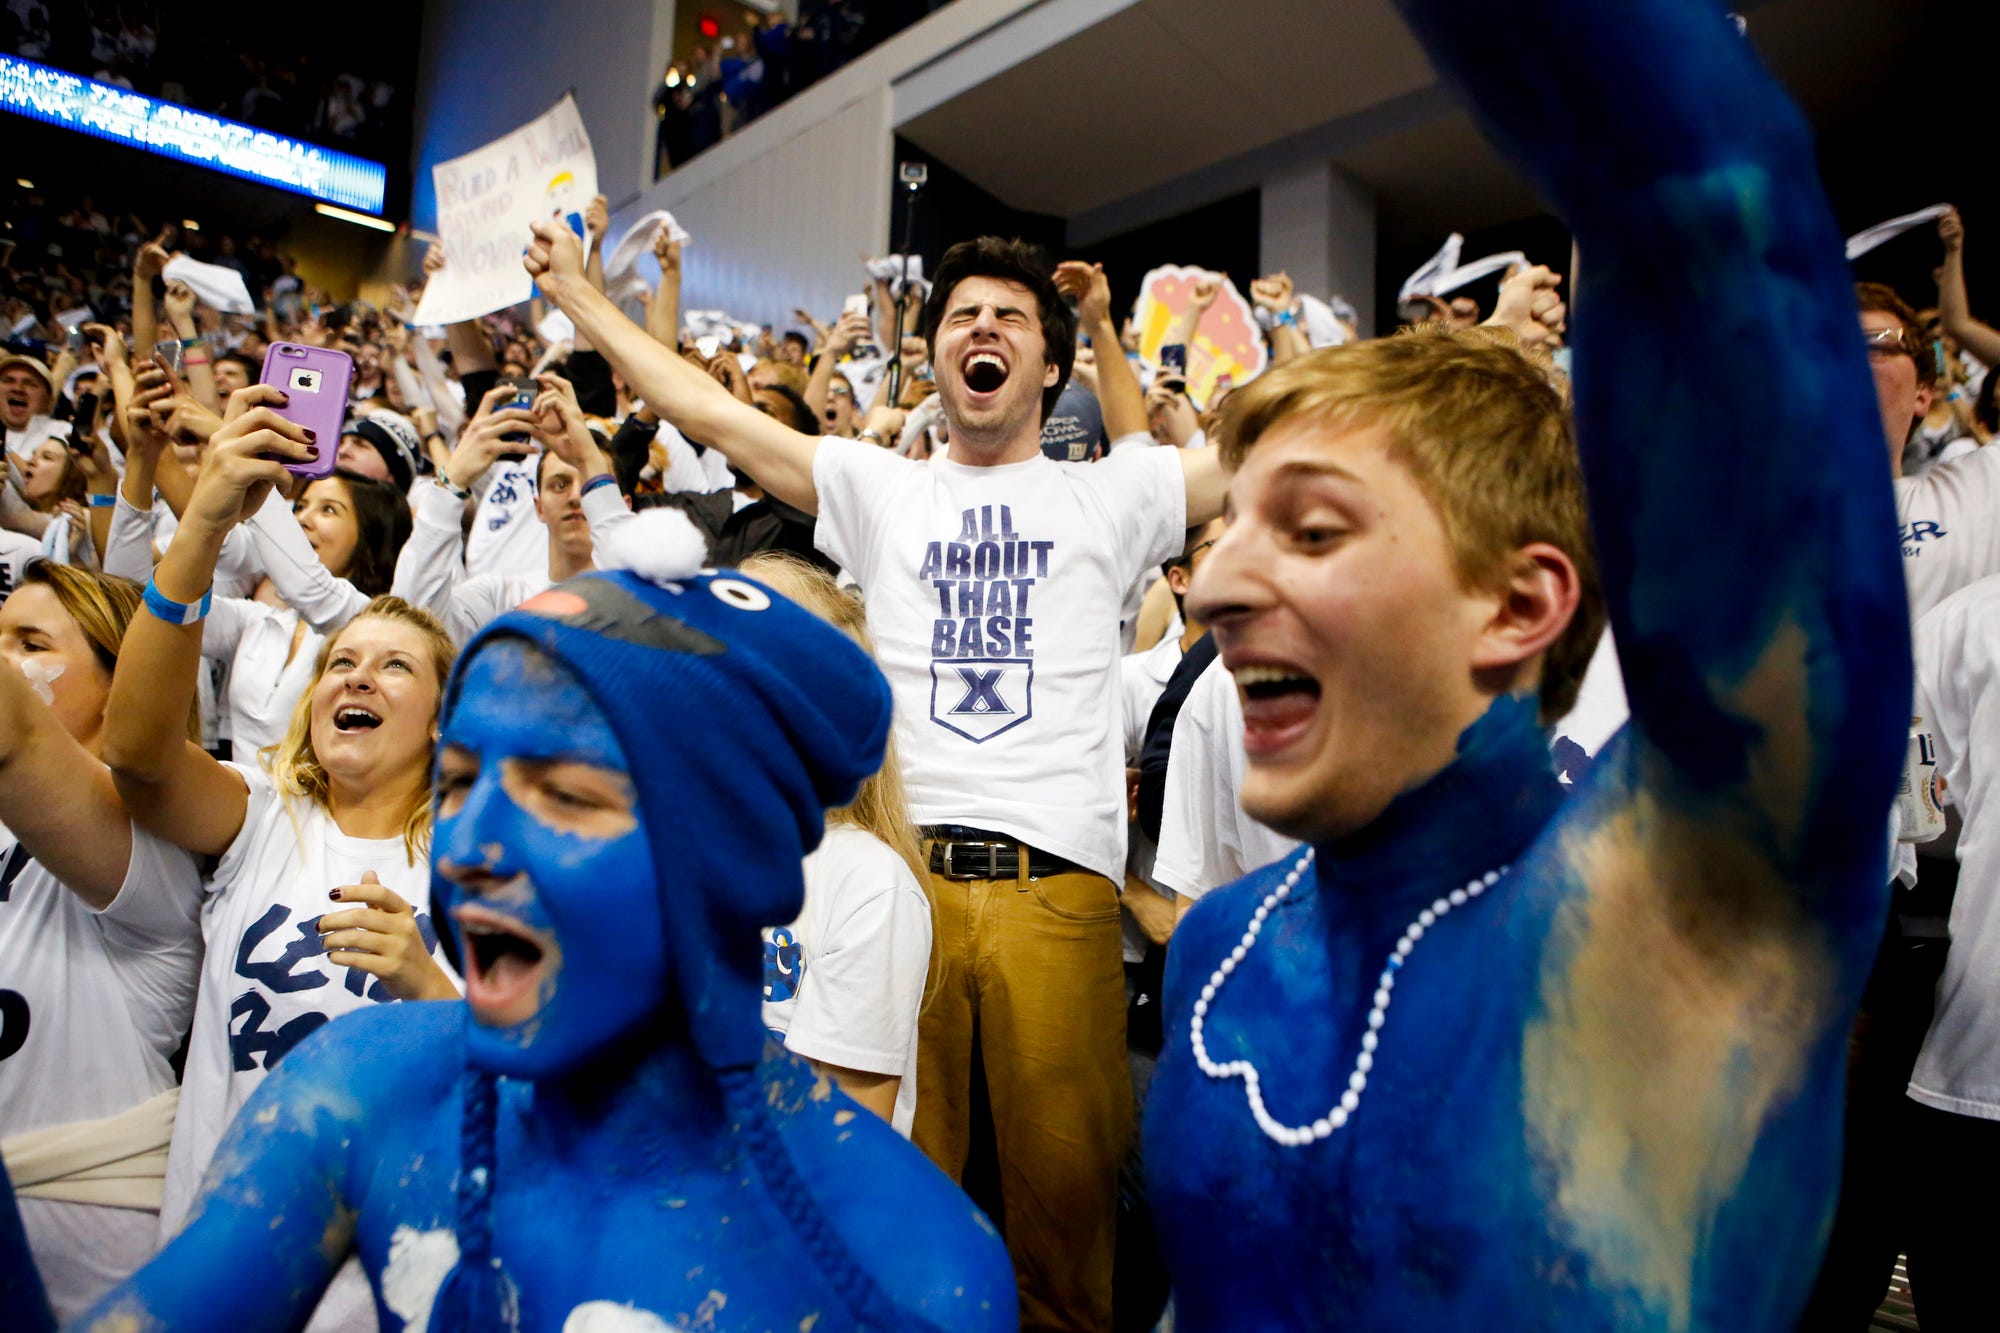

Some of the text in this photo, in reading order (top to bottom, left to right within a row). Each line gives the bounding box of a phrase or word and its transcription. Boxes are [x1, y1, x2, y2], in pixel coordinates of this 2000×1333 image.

[506, 155, 520, 184] A
[1040, 424, 1082, 437] OWL
[956, 504, 1020, 542] ALL
[919, 541, 1055, 581] ABOUT
[933, 578, 1036, 618] THAT
[931, 615, 1034, 658] BASE
[947, 667, 1016, 715] X
[1918, 733, 1937, 766] Li
